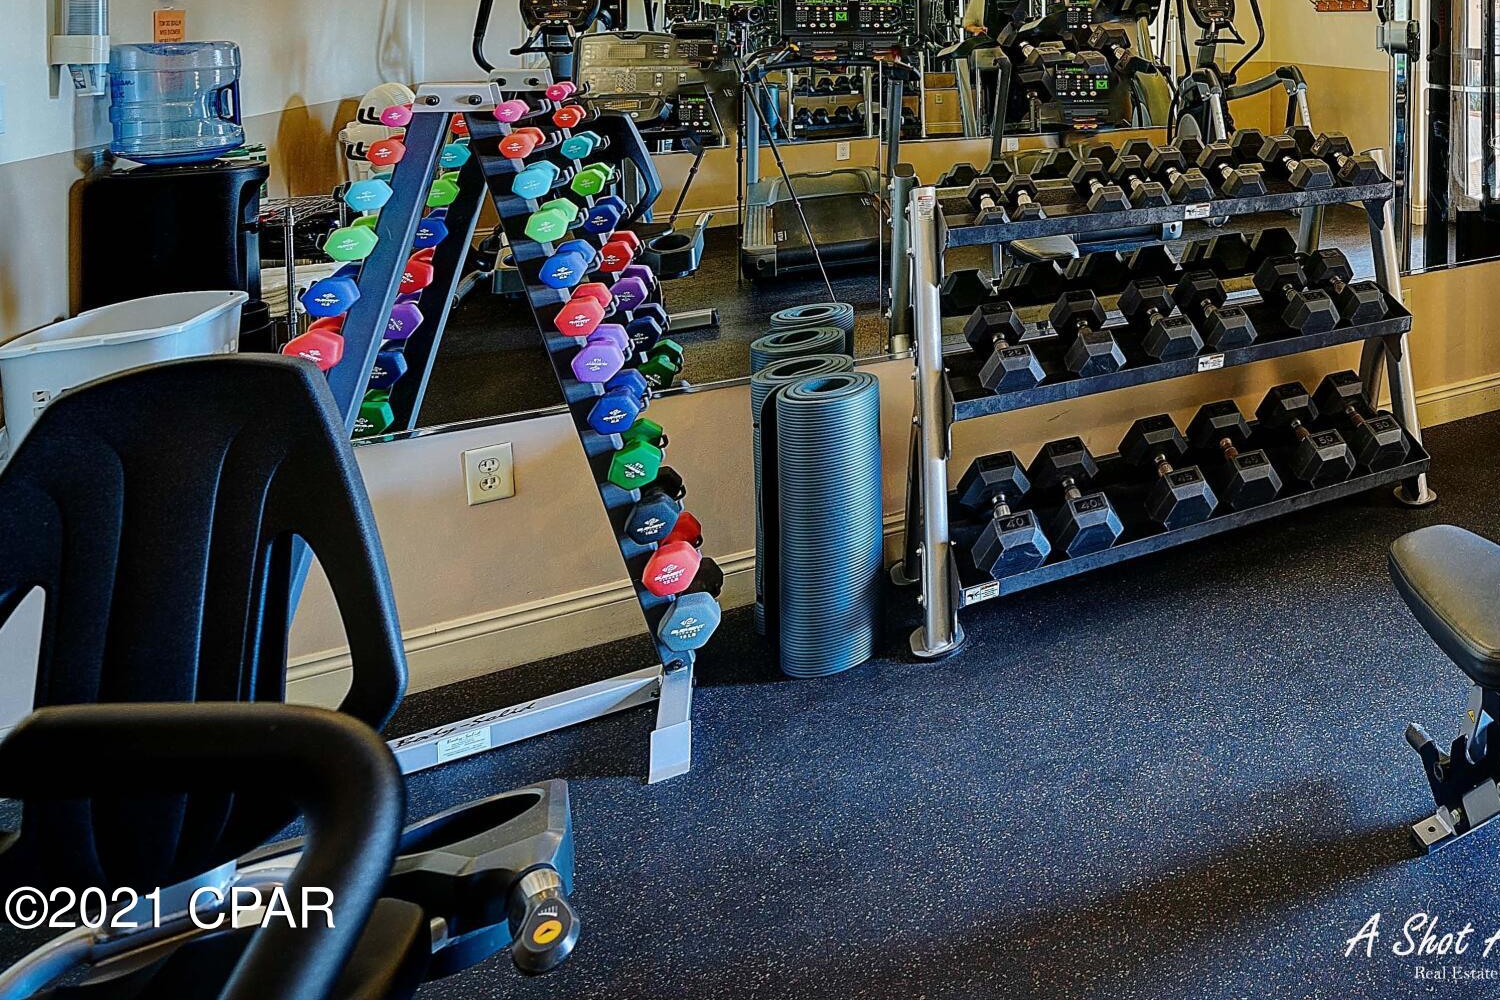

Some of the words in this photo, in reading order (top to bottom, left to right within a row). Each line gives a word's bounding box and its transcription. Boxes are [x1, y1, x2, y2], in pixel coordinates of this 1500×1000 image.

[1319, 435, 1334, 445] 50
[1080, 499, 1098, 510] 40
[1006, 517, 1024, 529] 40
